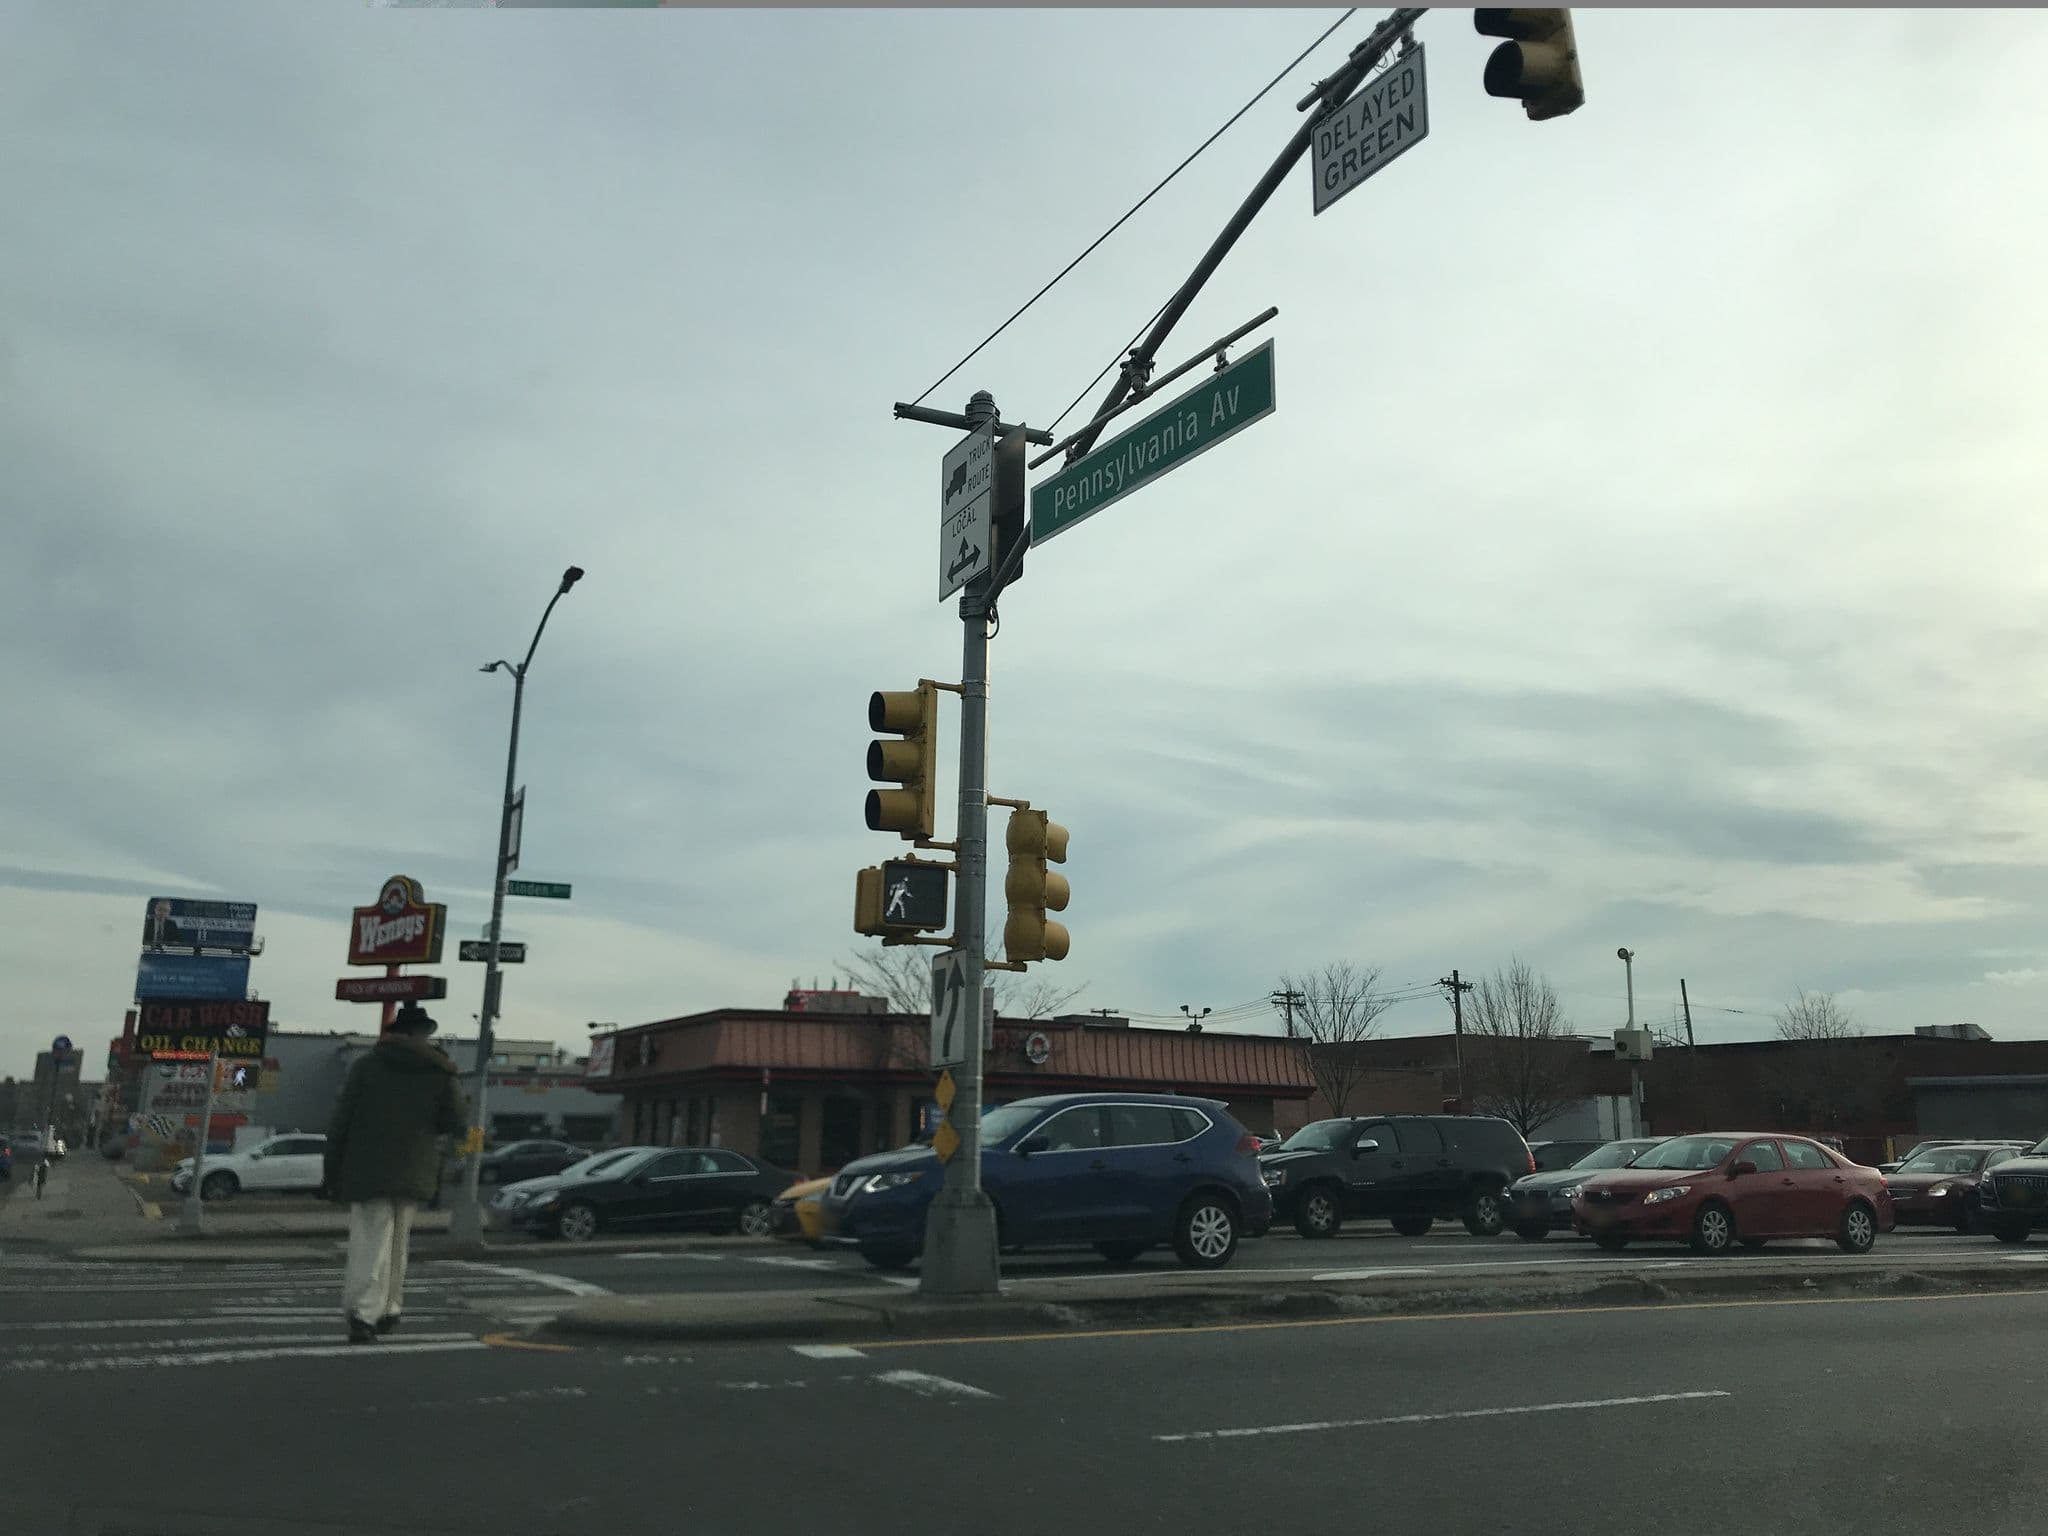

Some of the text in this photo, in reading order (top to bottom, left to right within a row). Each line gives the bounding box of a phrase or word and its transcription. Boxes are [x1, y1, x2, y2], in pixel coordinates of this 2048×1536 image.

[1320, 67, 1415, 161] DELAYED
[1324, 103, 1415, 191] GREEN
[968, 435, 991, 466] TRUCK
[1054, 385, 1240, 519] Pennsylvania Av
[967, 463, 990, 494] ROUTE
[952, 507, 977, 538] LOCAL
[145, 1001, 263, 1028] CAR WASH
[140, 1034, 172, 1050] OIL
[180, 1035, 262, 1055] CHANGE
